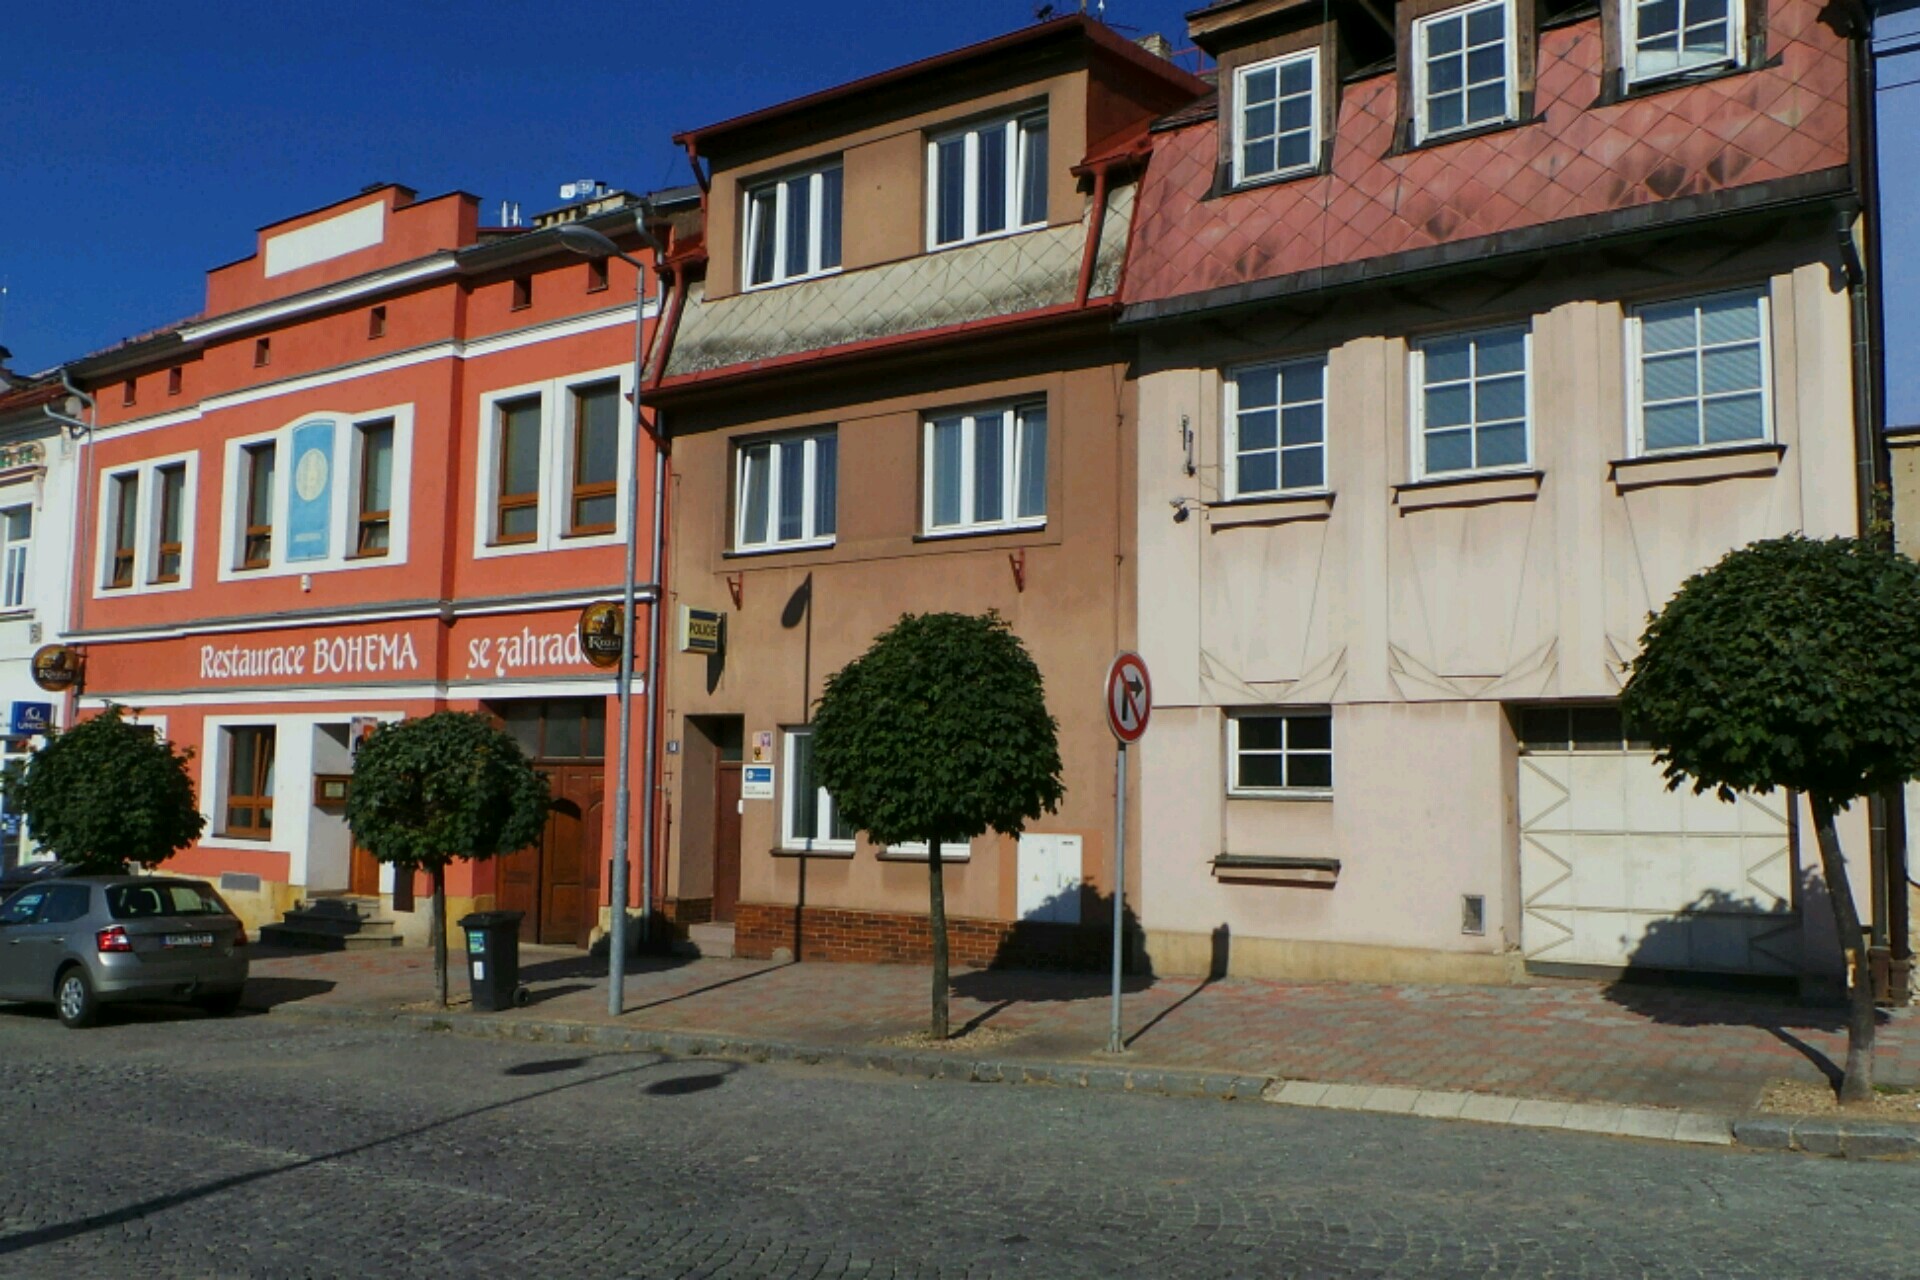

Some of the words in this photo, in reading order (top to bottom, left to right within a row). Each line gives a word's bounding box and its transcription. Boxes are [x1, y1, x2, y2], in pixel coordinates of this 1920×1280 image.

[200, 644, 305, 679] Restaurace
[313, 632, 418, 674] BOHEMA
[468, 637, 491, 668] se
[496, 623, 590, 677] zahrad
